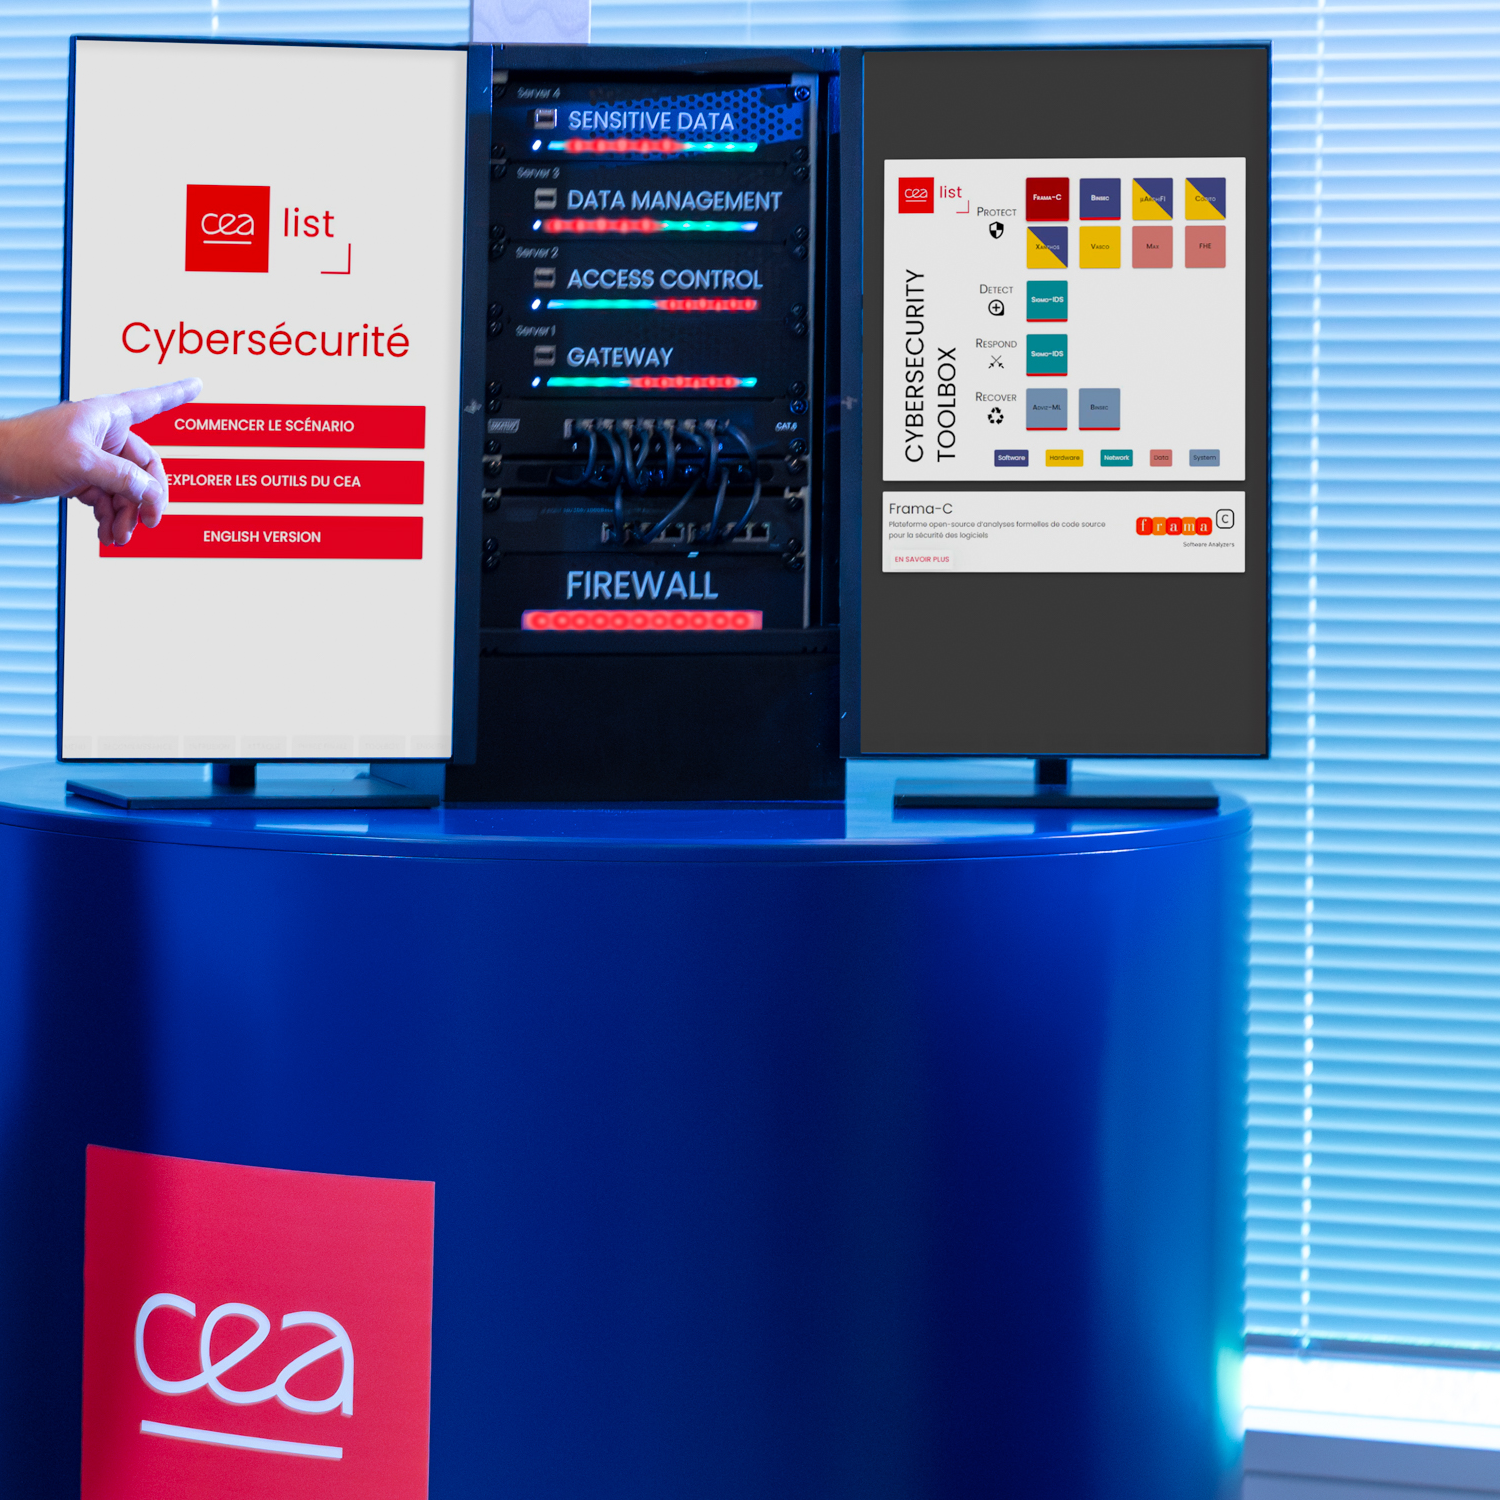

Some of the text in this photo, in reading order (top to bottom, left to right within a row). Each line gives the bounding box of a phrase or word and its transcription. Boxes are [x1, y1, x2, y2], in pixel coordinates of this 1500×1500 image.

[517, 87, 561, 99] Server 4
[568, 110, 735, 131] SENSITIVE DATA
[517, 167, 560, 179] Server 3
[905, 186, 962, 199] cea list
[568, 190, 782, 211] DATA MANAGEMENT
[201, 207, 334, 237] cea list
[1199, 242, 1211, 250] FHE
[516, 247, 559, 259] Server 2
[568, 269, 763, 289] ACCESS CONTROL
[516, 325, 556, 337] Server 1
[122, 321, 409, 364] Cybersécurité
[568, 347, 673, 366] GATEWAY
[905, 270, 924, 462] CYBERSECURITY
[938, 348, 956, 462] TOOLBOX
[175, 417, 354, 432] COMMENCER LE SCÉNARIO
[1193, 454, 1216, 462] System
[167, 474, 361, 487] EXPLORER LES OUTILS DU CEA
[890, 502, 952, 515] Frama-C
[1222, 513, 1228, 524] C
[889, 520, 927, 529] Plateforme
[929, 521, 975, 531] open-source
[1016, 520, 1049, 528] formelles
[1051, 520, 1060, 528] de
[1062, 520, 1080, 528] code
[204, 531, 321, 542] ENGLISH VERSION
[889, 531, 988, 541] pour la sécurité des logiciels
[906, 555, 931, 563] SAVOIR
[933, 555, 949, 563] PLUS
[567, 571, 718, 599] FIREWALL
[135, 1293, 354, 1417] cea
